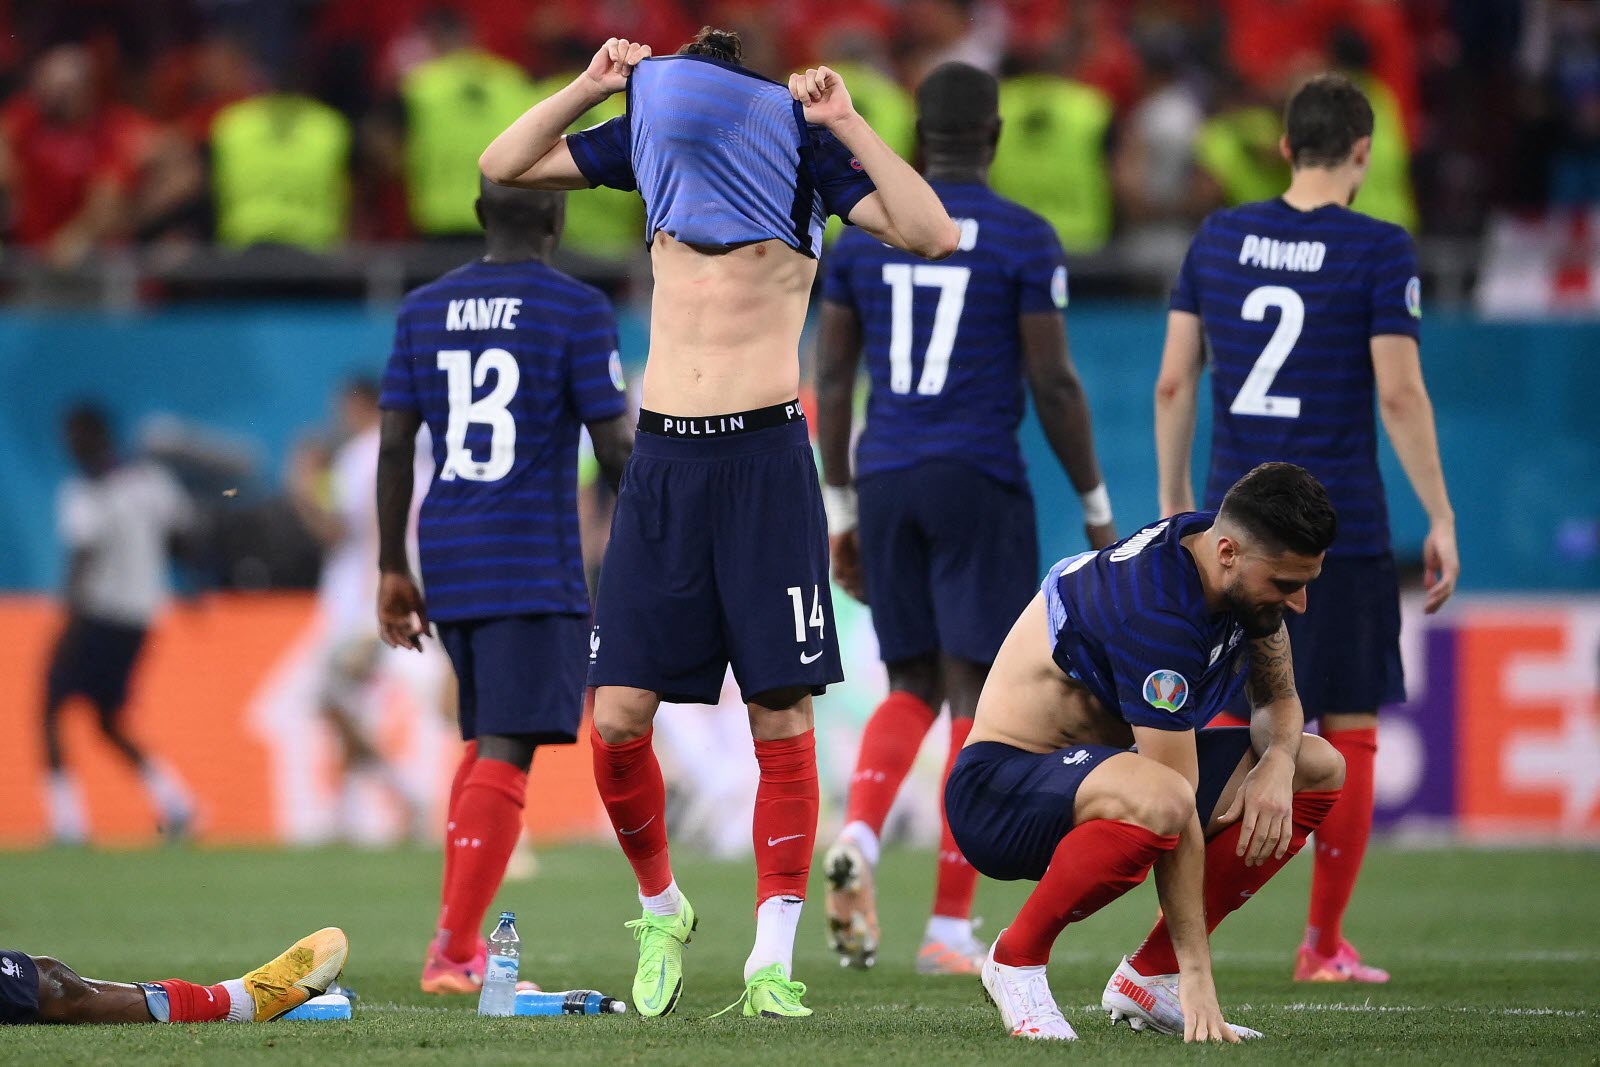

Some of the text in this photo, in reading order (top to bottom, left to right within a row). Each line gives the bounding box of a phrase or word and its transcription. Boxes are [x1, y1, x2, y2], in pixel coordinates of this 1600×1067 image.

[1238, 234, 1326, 272] PAVARD
[446, 298, 522, 331] KANTE
[882, 263, 971, 395] 17
[1230, 285, 1305, 418] 2
[437, 348, 520, 482] 13
[663, 401, 804, 435] PULLIN PU
[787, 584, 825, 643] 14
